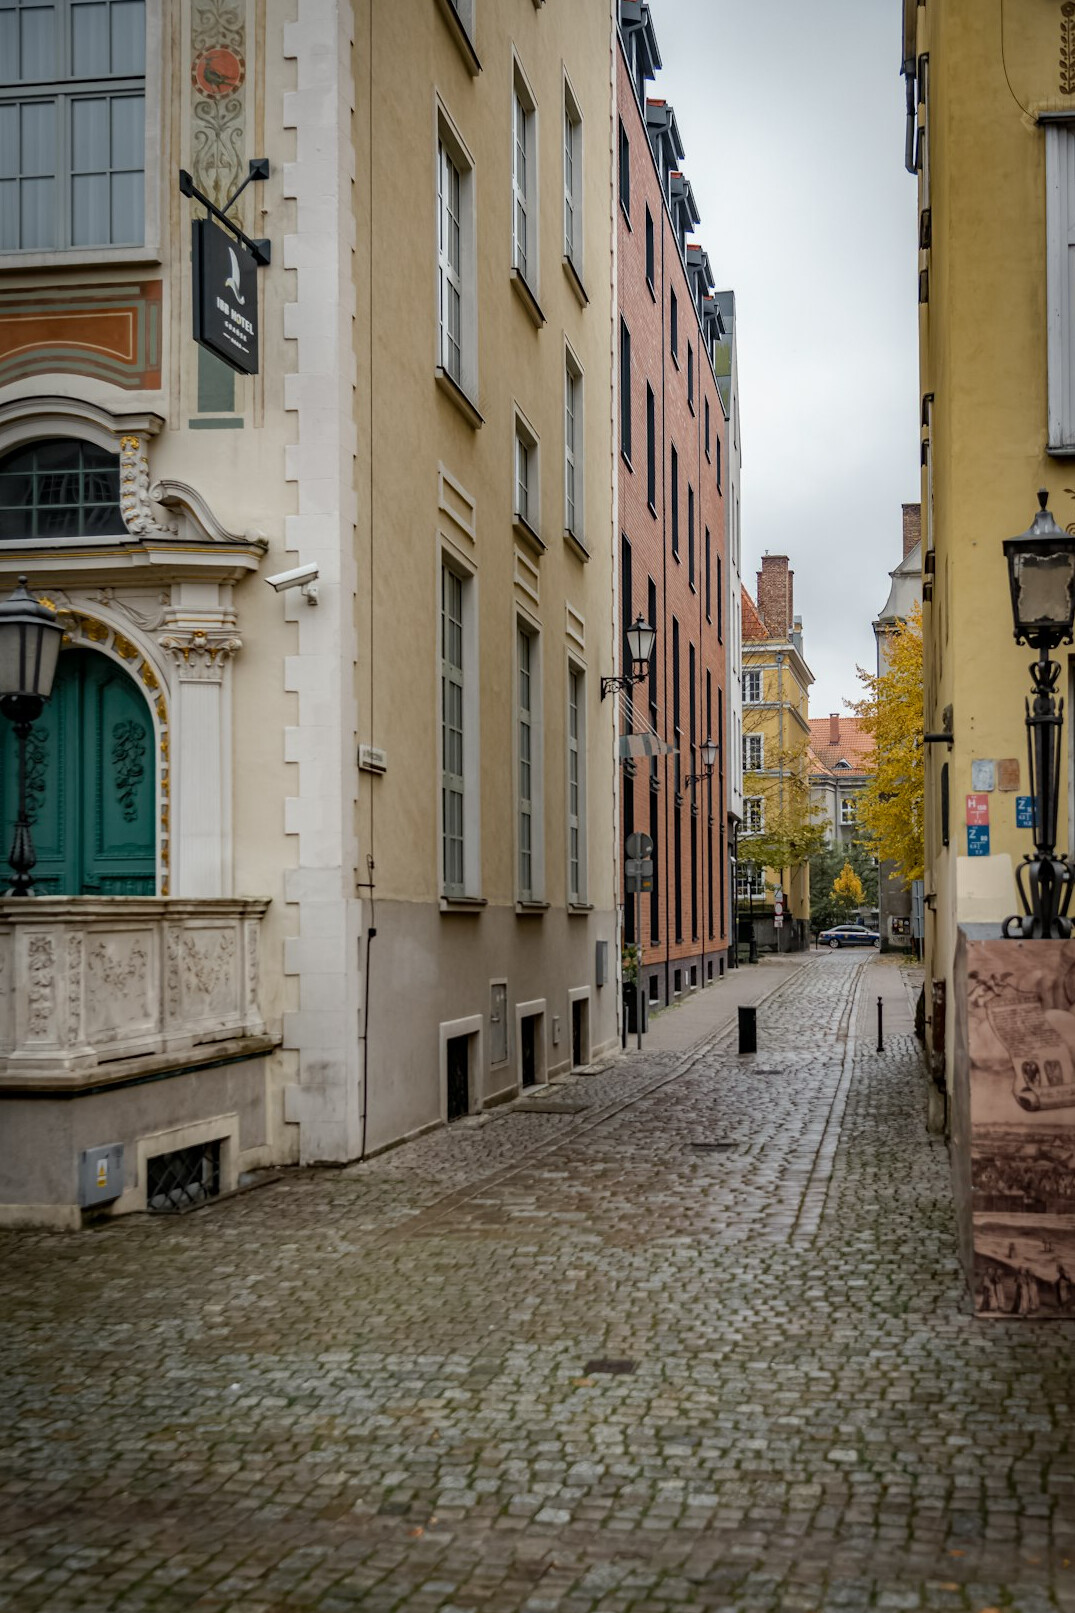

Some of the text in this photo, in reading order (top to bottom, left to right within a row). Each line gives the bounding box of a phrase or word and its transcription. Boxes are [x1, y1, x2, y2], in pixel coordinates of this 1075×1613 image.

[216, 296, 254, 335] IBB HOTEL
[968, 798, 975, 808] H
[1018, 800, 1025, 809] Z
[968, 829, 976, 838] Z
